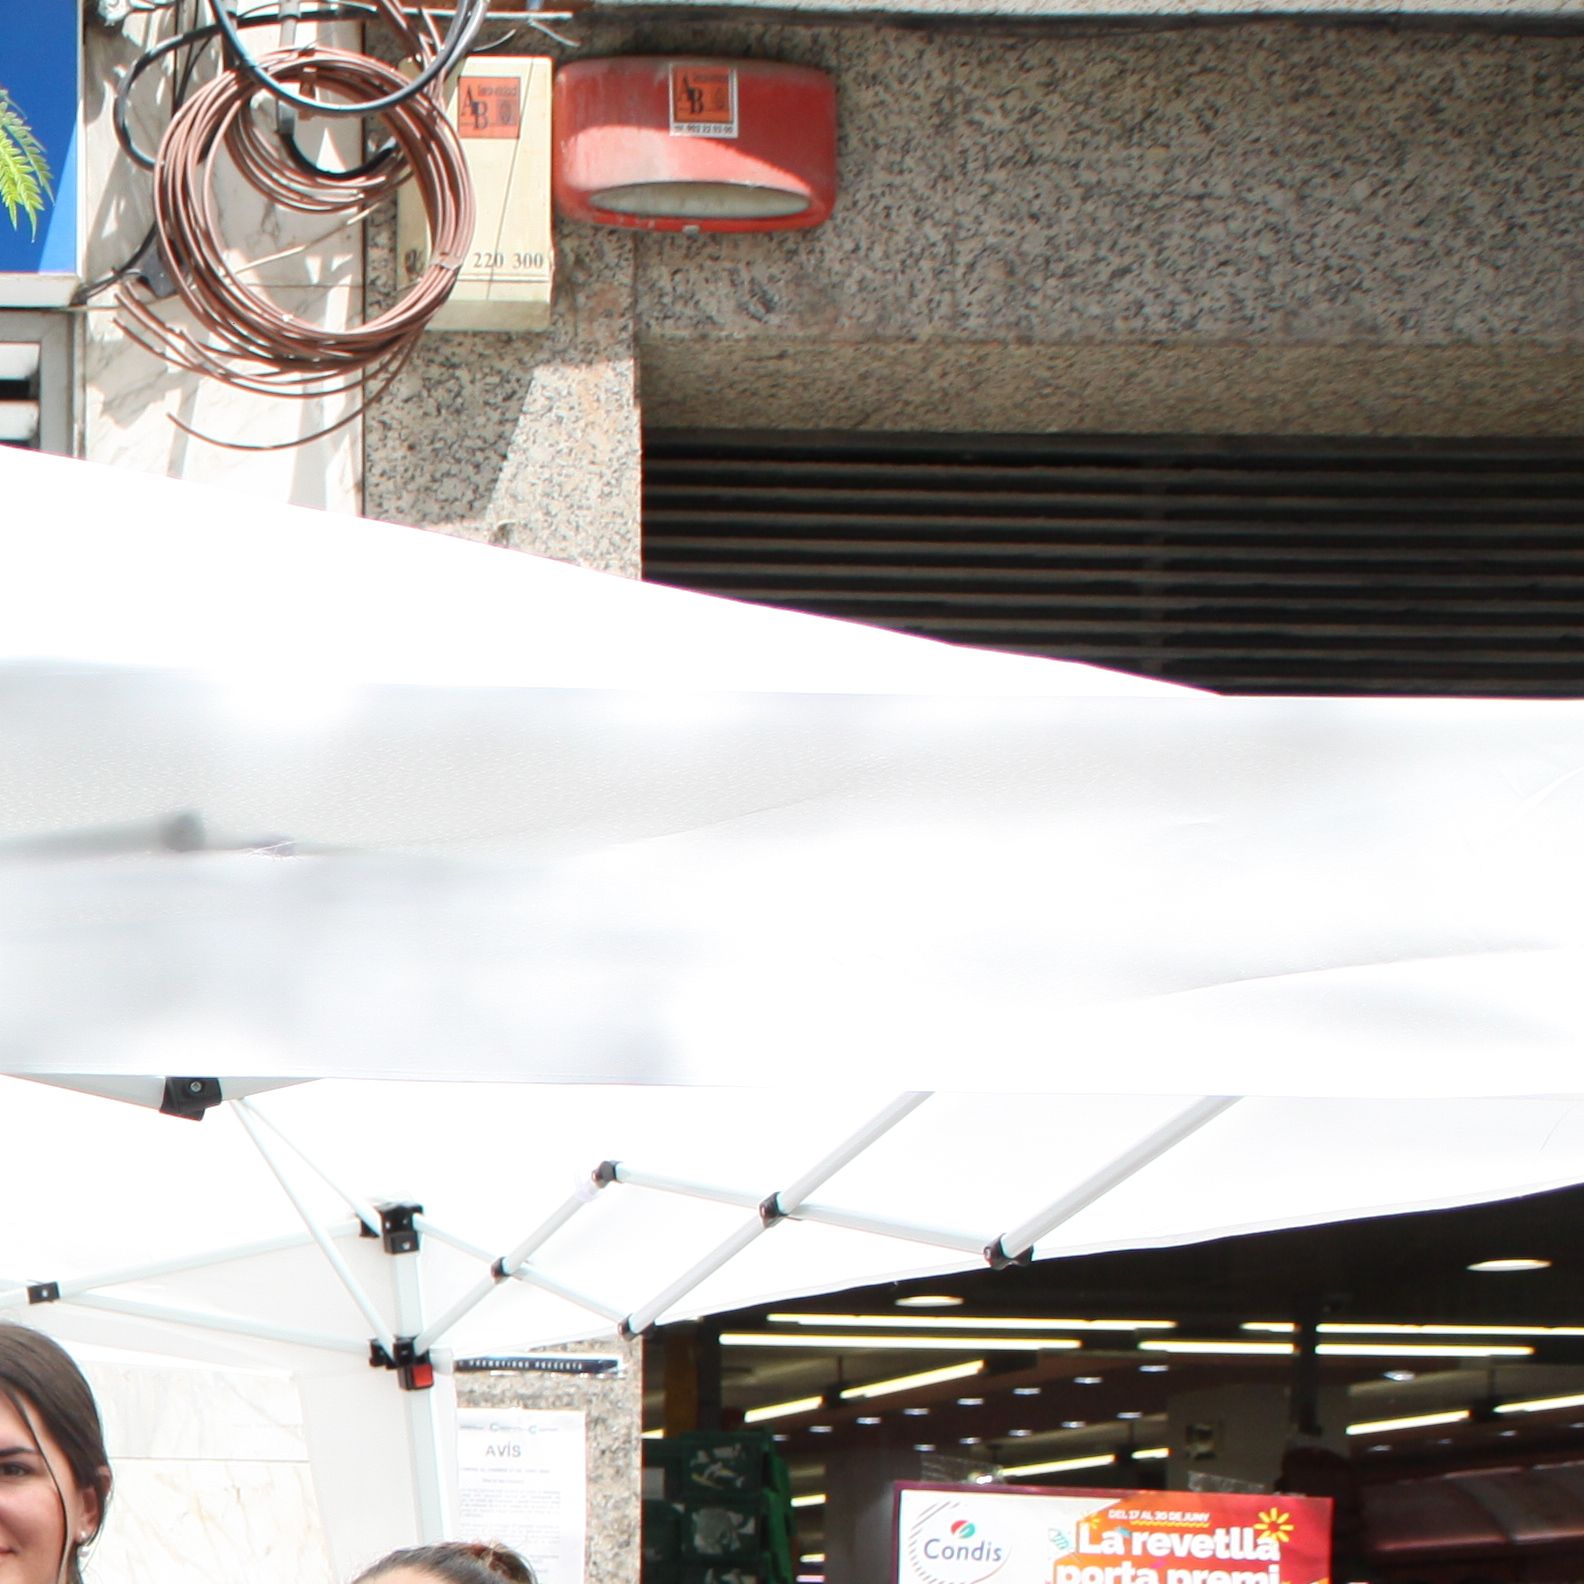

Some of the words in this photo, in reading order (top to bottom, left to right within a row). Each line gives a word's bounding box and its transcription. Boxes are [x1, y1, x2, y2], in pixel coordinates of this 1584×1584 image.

[473, 252, 505, 268] 220
[513, 252, 544, 268] 300
[924, 1537, 1002, 1563] Condis
[1079, 1523, 1124, 1556] La
[1131, 1527, 1281, 1561] revetlla
